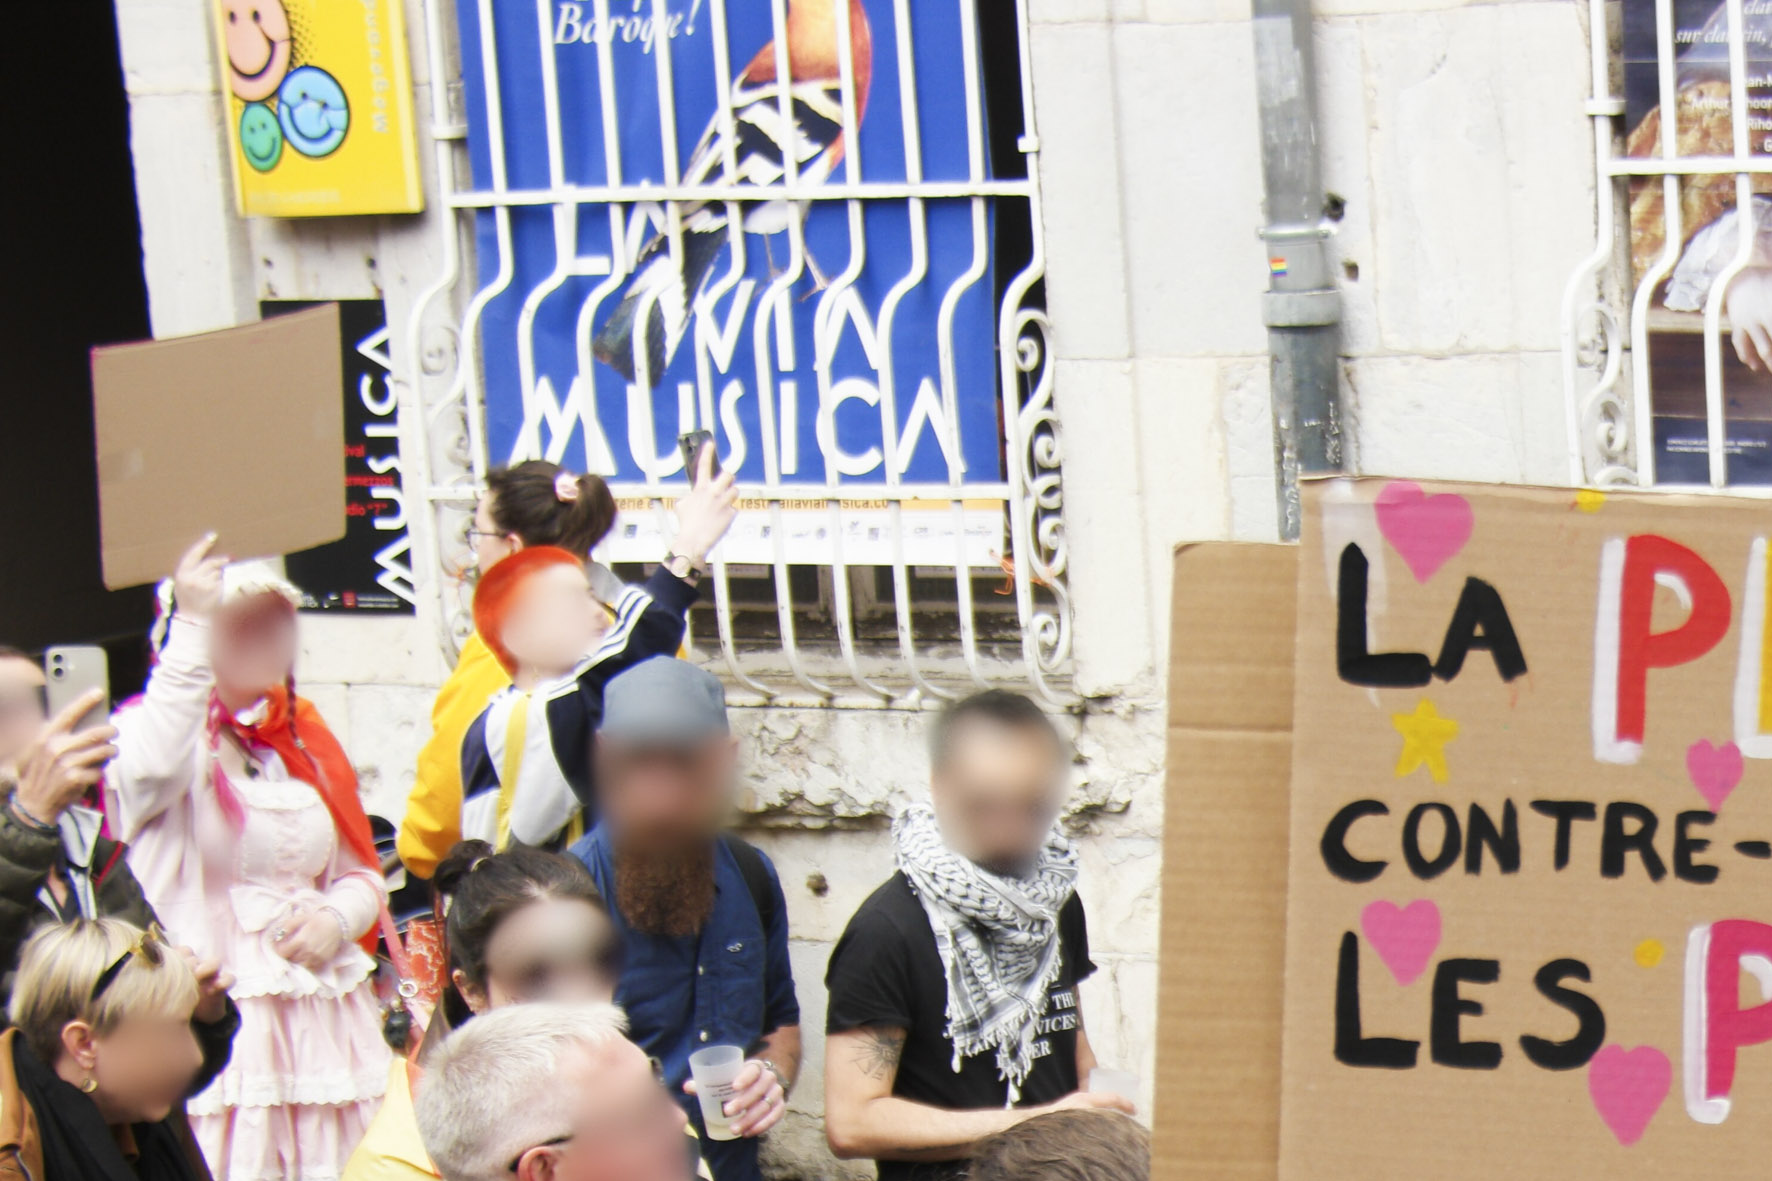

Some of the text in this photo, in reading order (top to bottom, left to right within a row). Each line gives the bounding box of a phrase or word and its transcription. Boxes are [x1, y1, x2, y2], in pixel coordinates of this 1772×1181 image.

[508, 375, 968, 478] MUSICA
[1337, 543, 1529, 688] LA
[1332, 930, 1607, 1071] LES
